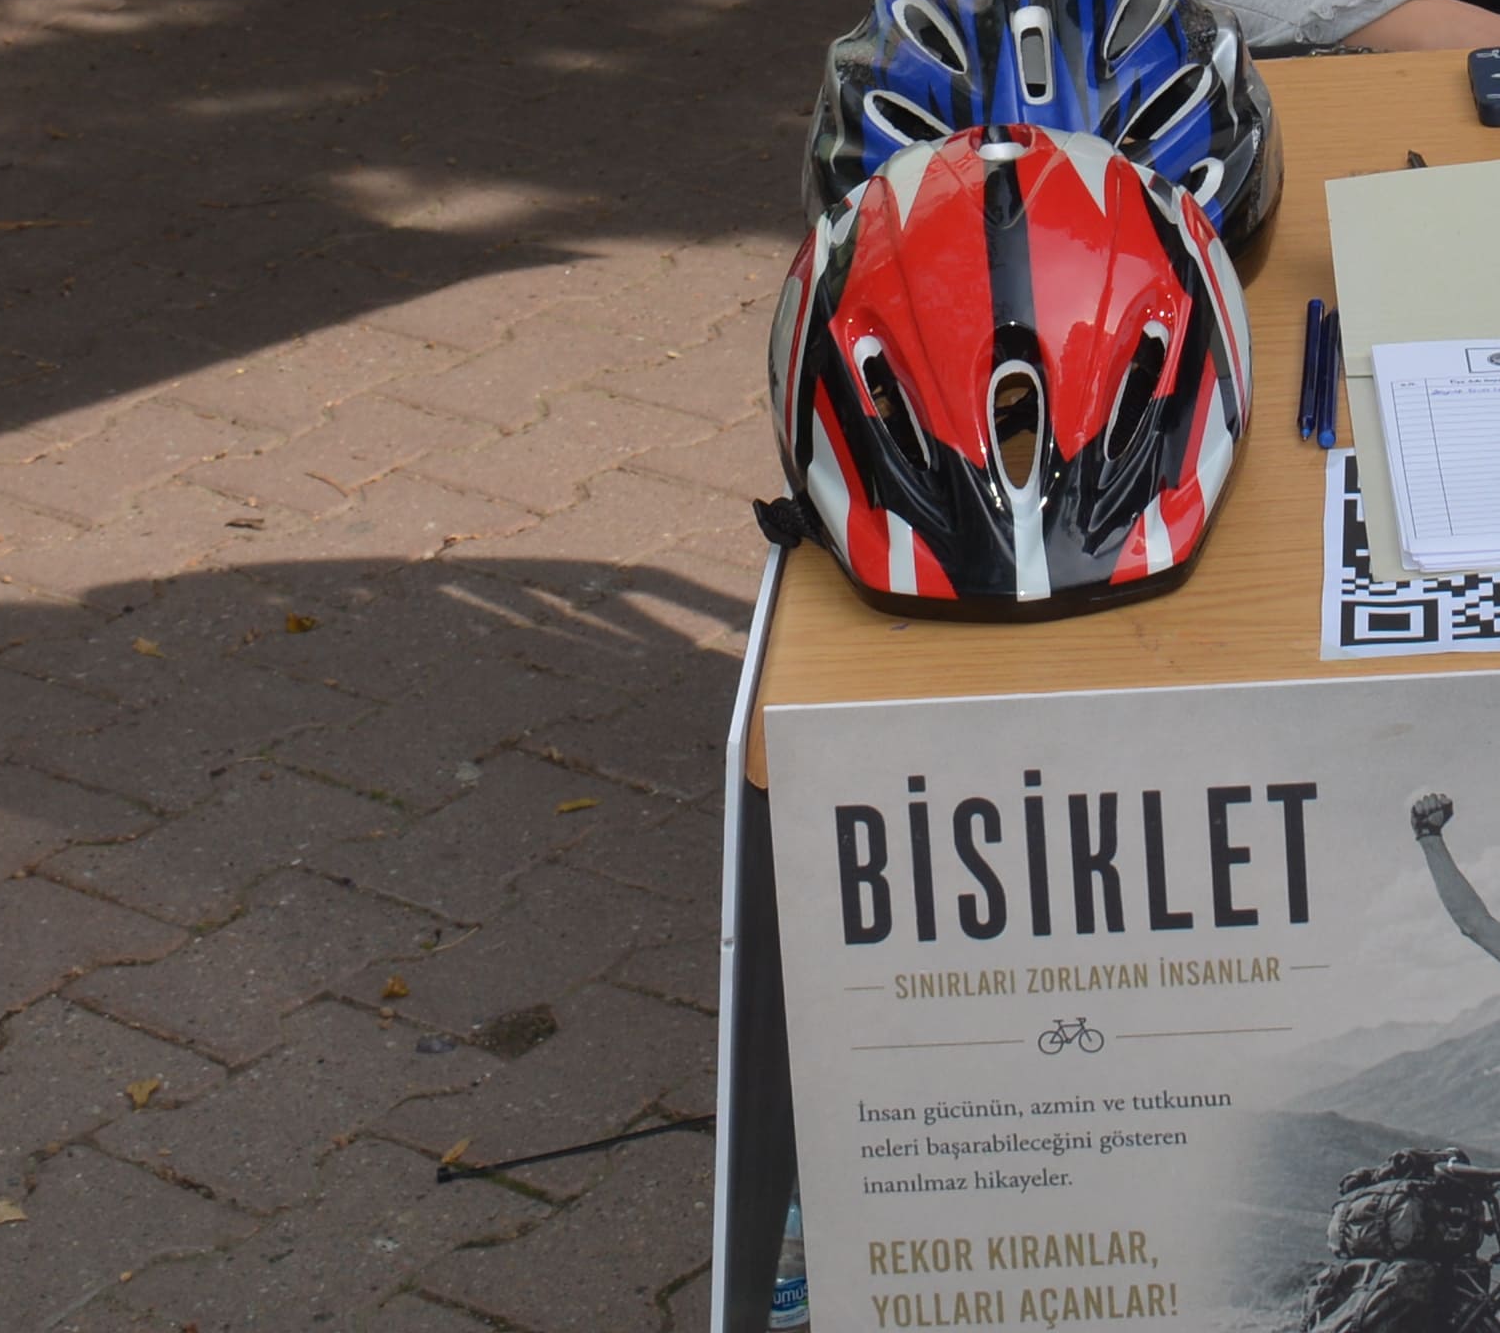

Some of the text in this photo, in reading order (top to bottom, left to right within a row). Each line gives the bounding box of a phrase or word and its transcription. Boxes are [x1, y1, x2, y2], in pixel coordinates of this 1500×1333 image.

[835, 770, 1318, 945] BİSİKLET
[895, 957, 1281, 1000] SINIRLARI ZORLAYAN İNSANLAR
[859, 1091, 1232, 1126] İnsan gücünün, azmin ve tutkunun
[860, 1130, 1188, 1161] neleri başarabileceğini gösteren
[863, 1169, 1073, 1195] inanılmaz hikayeler.
[869, 1231, 1159, 1275] REKOR KIRANLAR,
[872, 1282, 1178, 1328] YOLLARI AÇANLAR!
